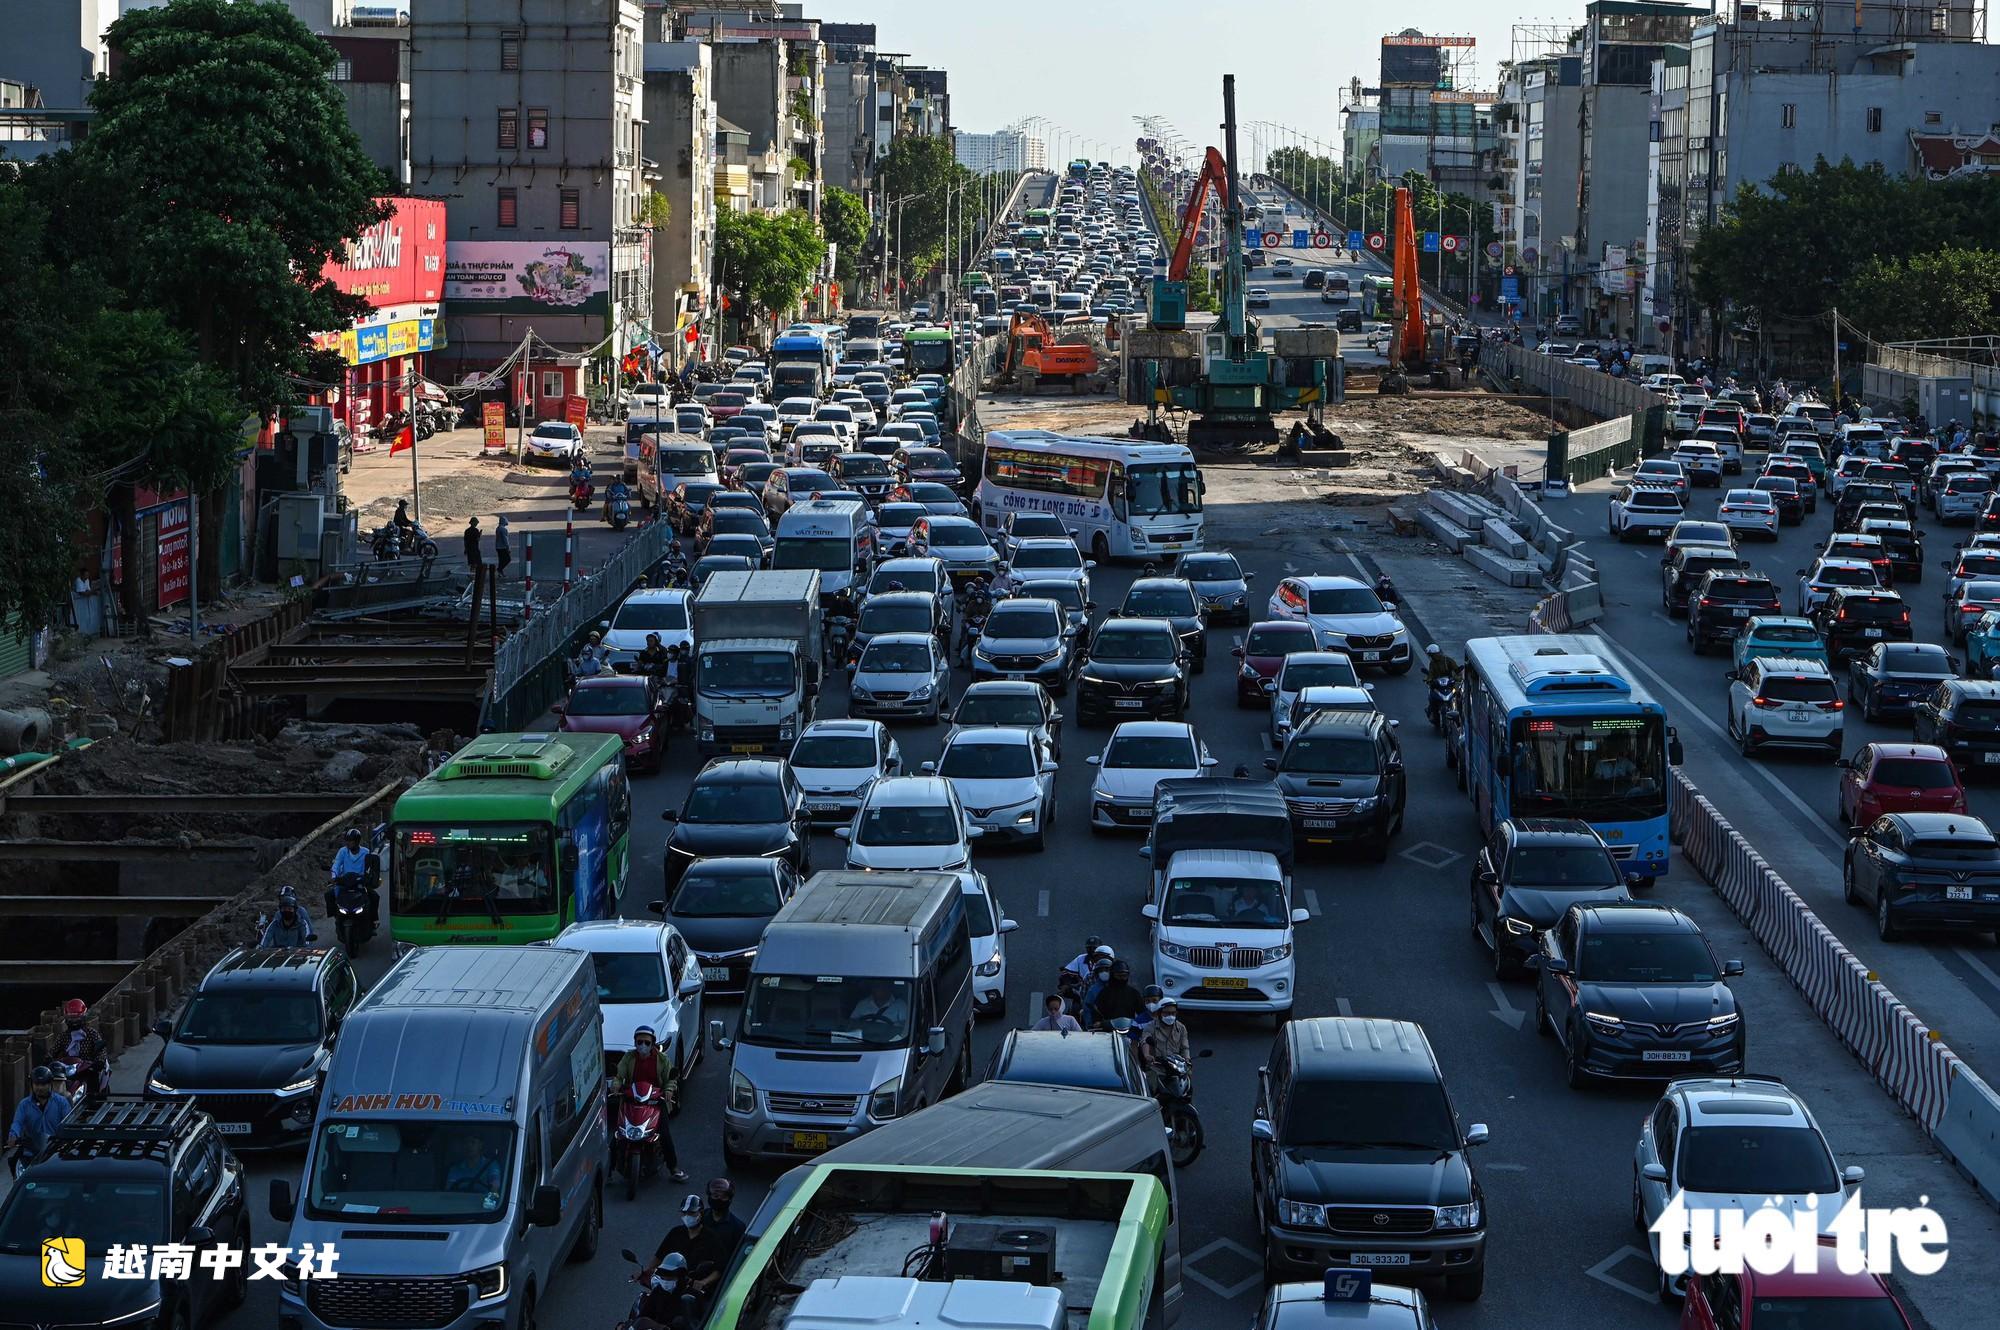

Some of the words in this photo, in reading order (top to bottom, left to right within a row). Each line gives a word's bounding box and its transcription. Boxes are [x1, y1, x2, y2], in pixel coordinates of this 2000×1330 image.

[1268, 234, 1276, 244] 60
[1318, 234, 1326, 244] 60
[1372, 236, 1380, 246] 60
[1445, 238, 1454, 248] 40
[469, 262, 489, 272] THỰC
[1003, 492, 1026, 509] CÔNG
[1028, 496, 1039, 511] TY
[1041, 498, 1064, 515] LONG
[1066, 498, 1086, 516] ĐỨC
[334, 1094, 391, 1112] ANH
[395, 1093, 443, 1111] HUY
[1355, 1255, 1406, 1264] 30L-933.20
